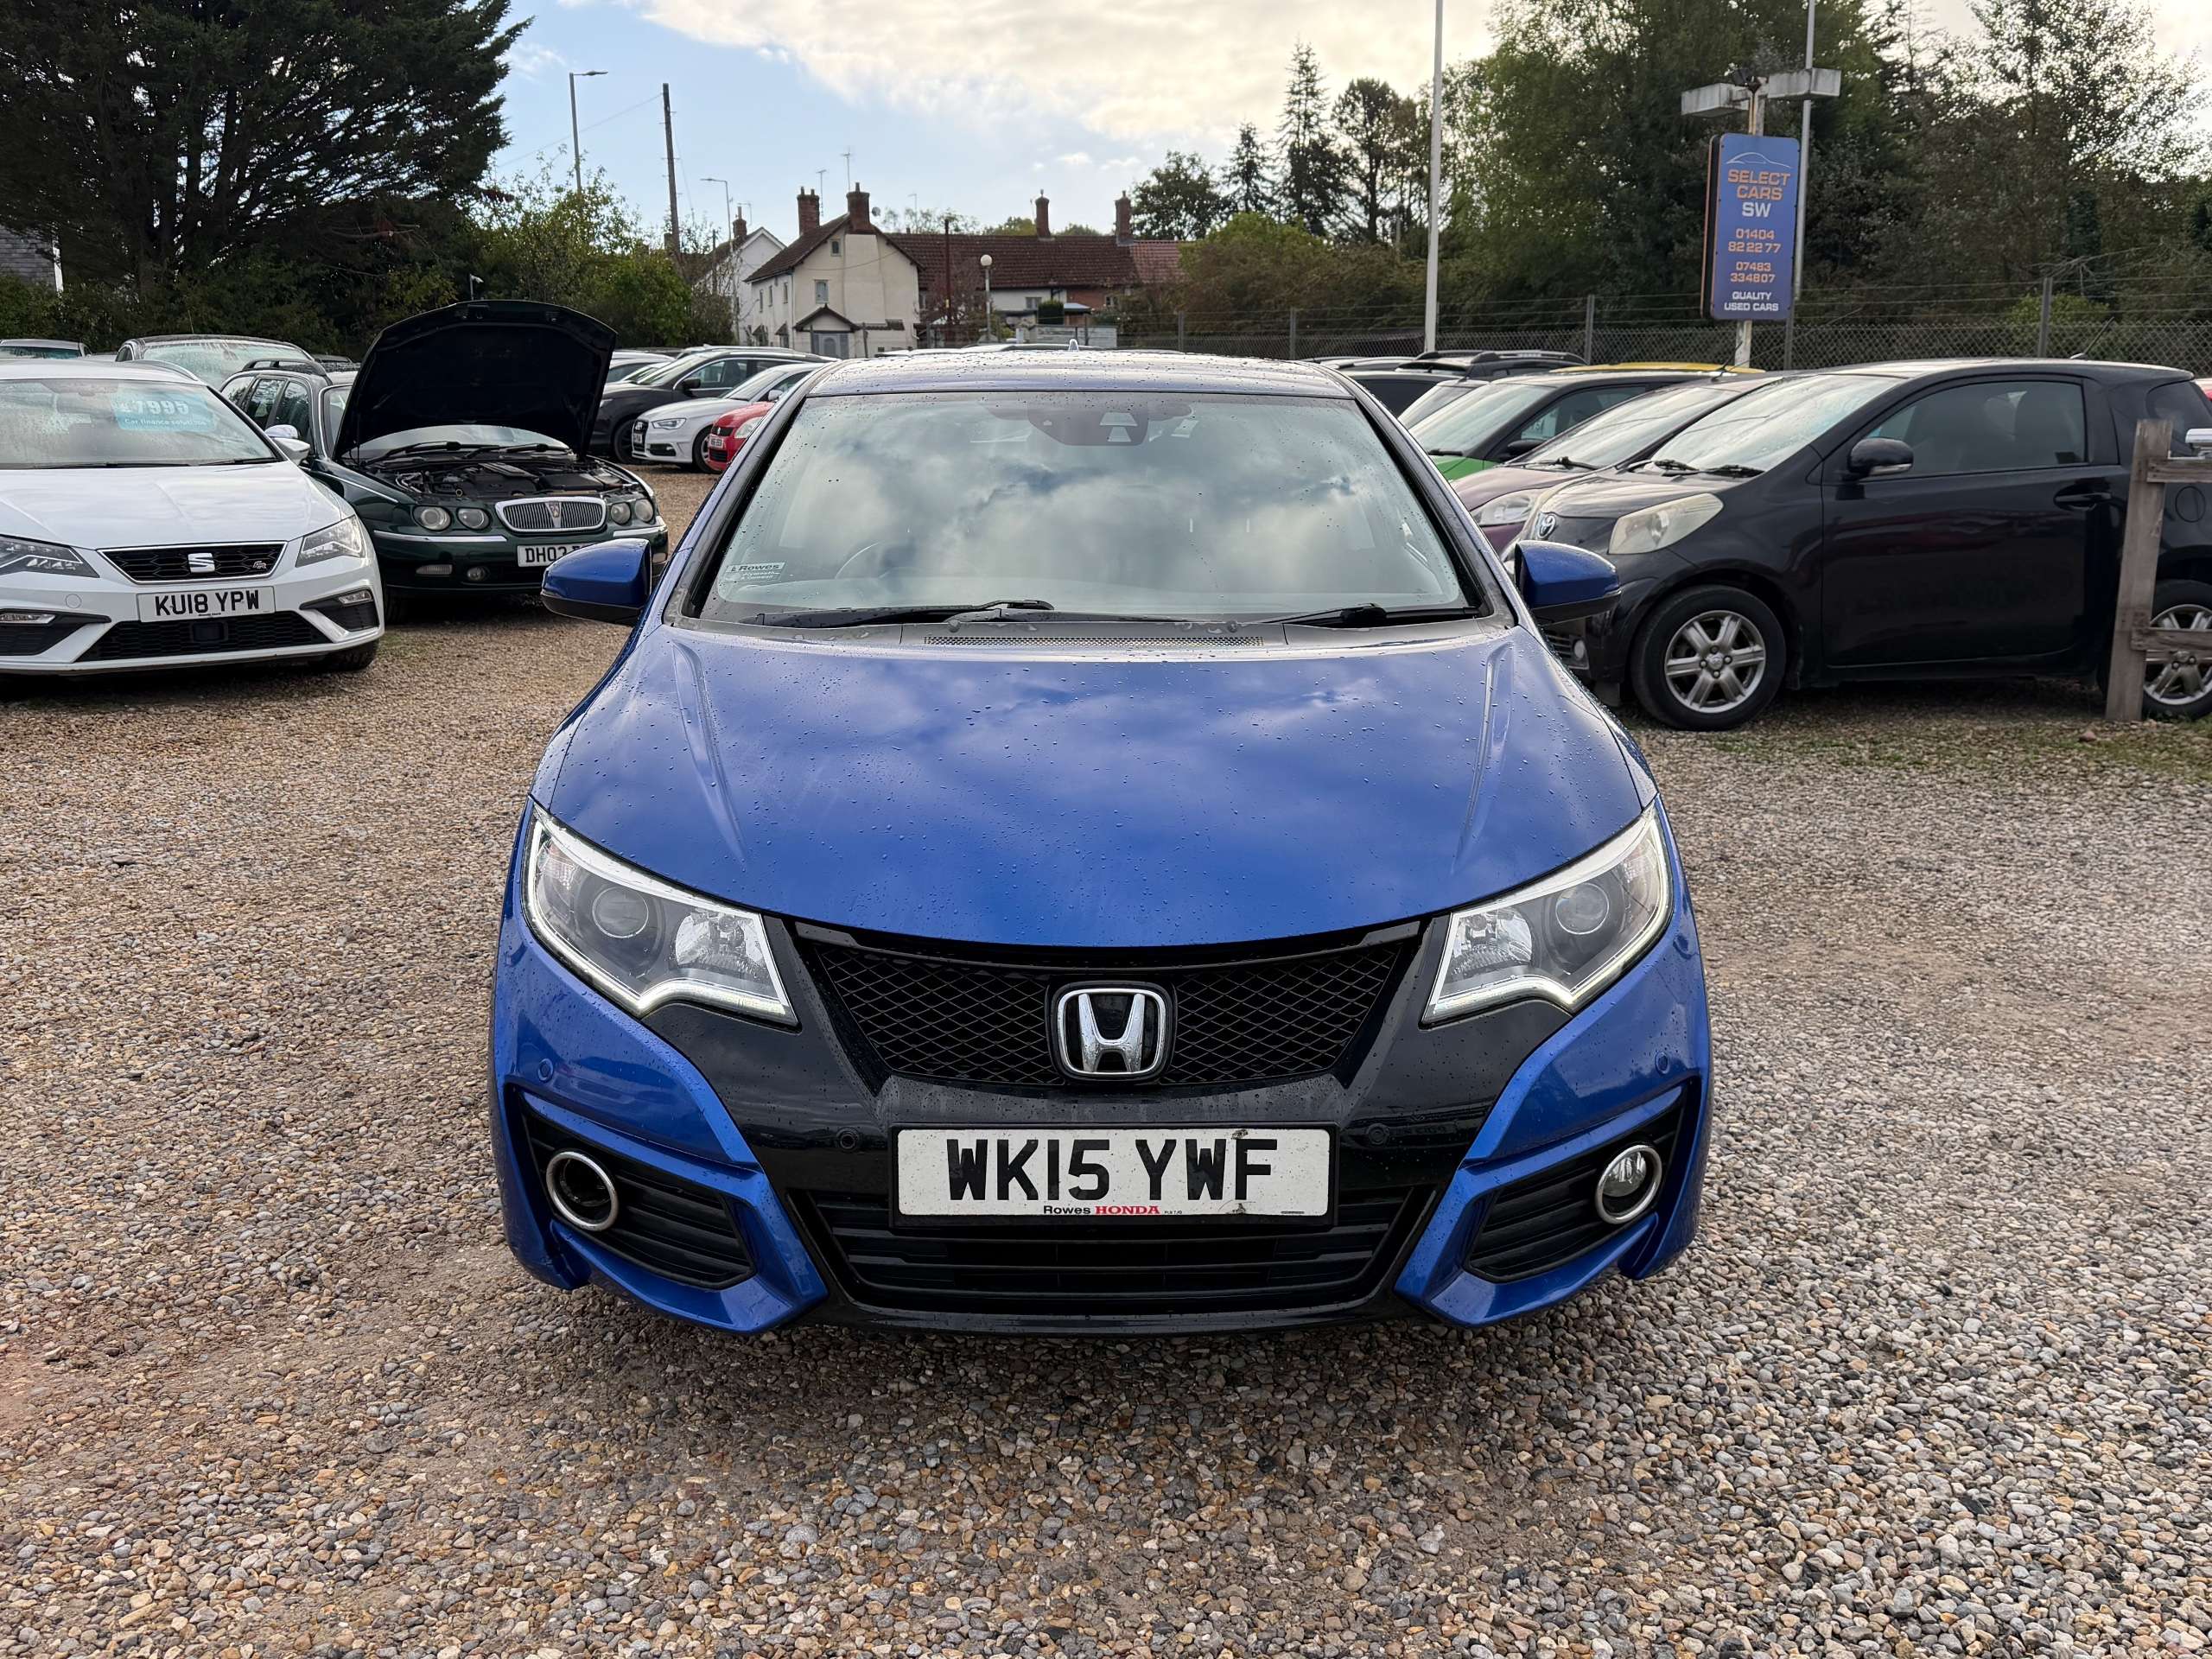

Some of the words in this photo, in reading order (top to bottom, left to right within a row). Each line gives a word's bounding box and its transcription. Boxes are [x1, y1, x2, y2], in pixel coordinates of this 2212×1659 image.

[1728, 169, 1790, 186] SELECT
[1737, 185, 1783, 200] CARS
[1742, 201, 1771, 218] SW
[1736, 228, 1775, 239] 01404
[1736, 261, 1771, 272] 07483
[1730, 273, 1776, 283] 334807
[1732, 291, 1771, 301] QUALITY
[1724, 302, 1751, 311] USED
[1752, 302, 1779, 312] CARS
[155, 594, 208, 616] KU18
[215, 589, 259, 612] YPW
[947, 1139, 1109, 1200] WK15
[1135, 1139, 1277, 1200] YWF
[1043, 1205, 1091, 1214] Rowes
[1095, 1205, 1160, 1215] HONDA
